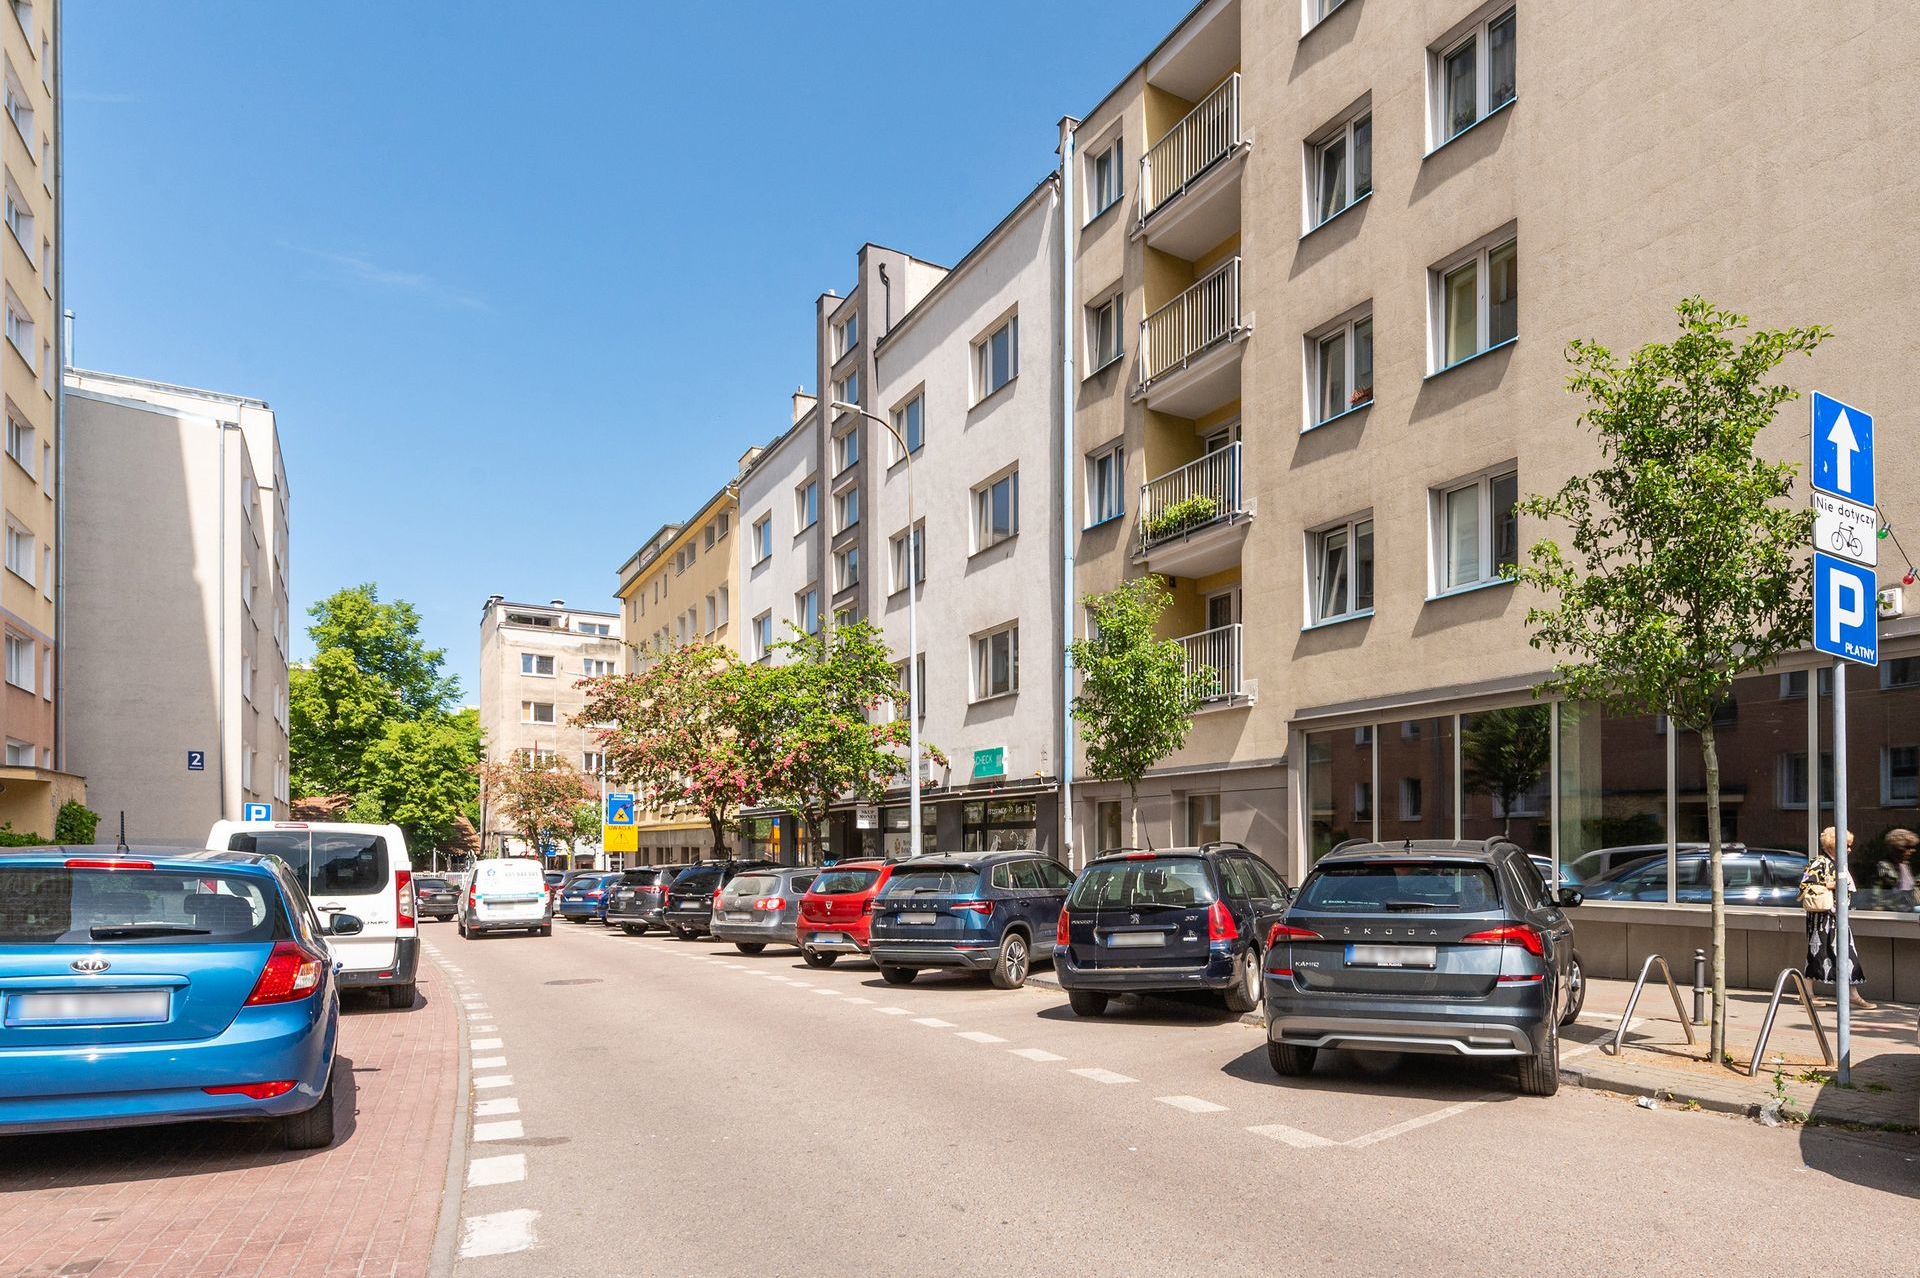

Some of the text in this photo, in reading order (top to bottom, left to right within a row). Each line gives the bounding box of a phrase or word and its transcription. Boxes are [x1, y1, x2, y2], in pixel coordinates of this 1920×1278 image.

[1816, 496, 1875, 529] Nie dotyczy
[1829, 567, 1864, 644] P
[1845, 641, 1875, 661] PŁATNY
[191, 753, 202, 766] 2
[250, 805, 267, 821] P
[77, 960, 105, 970] KIA
